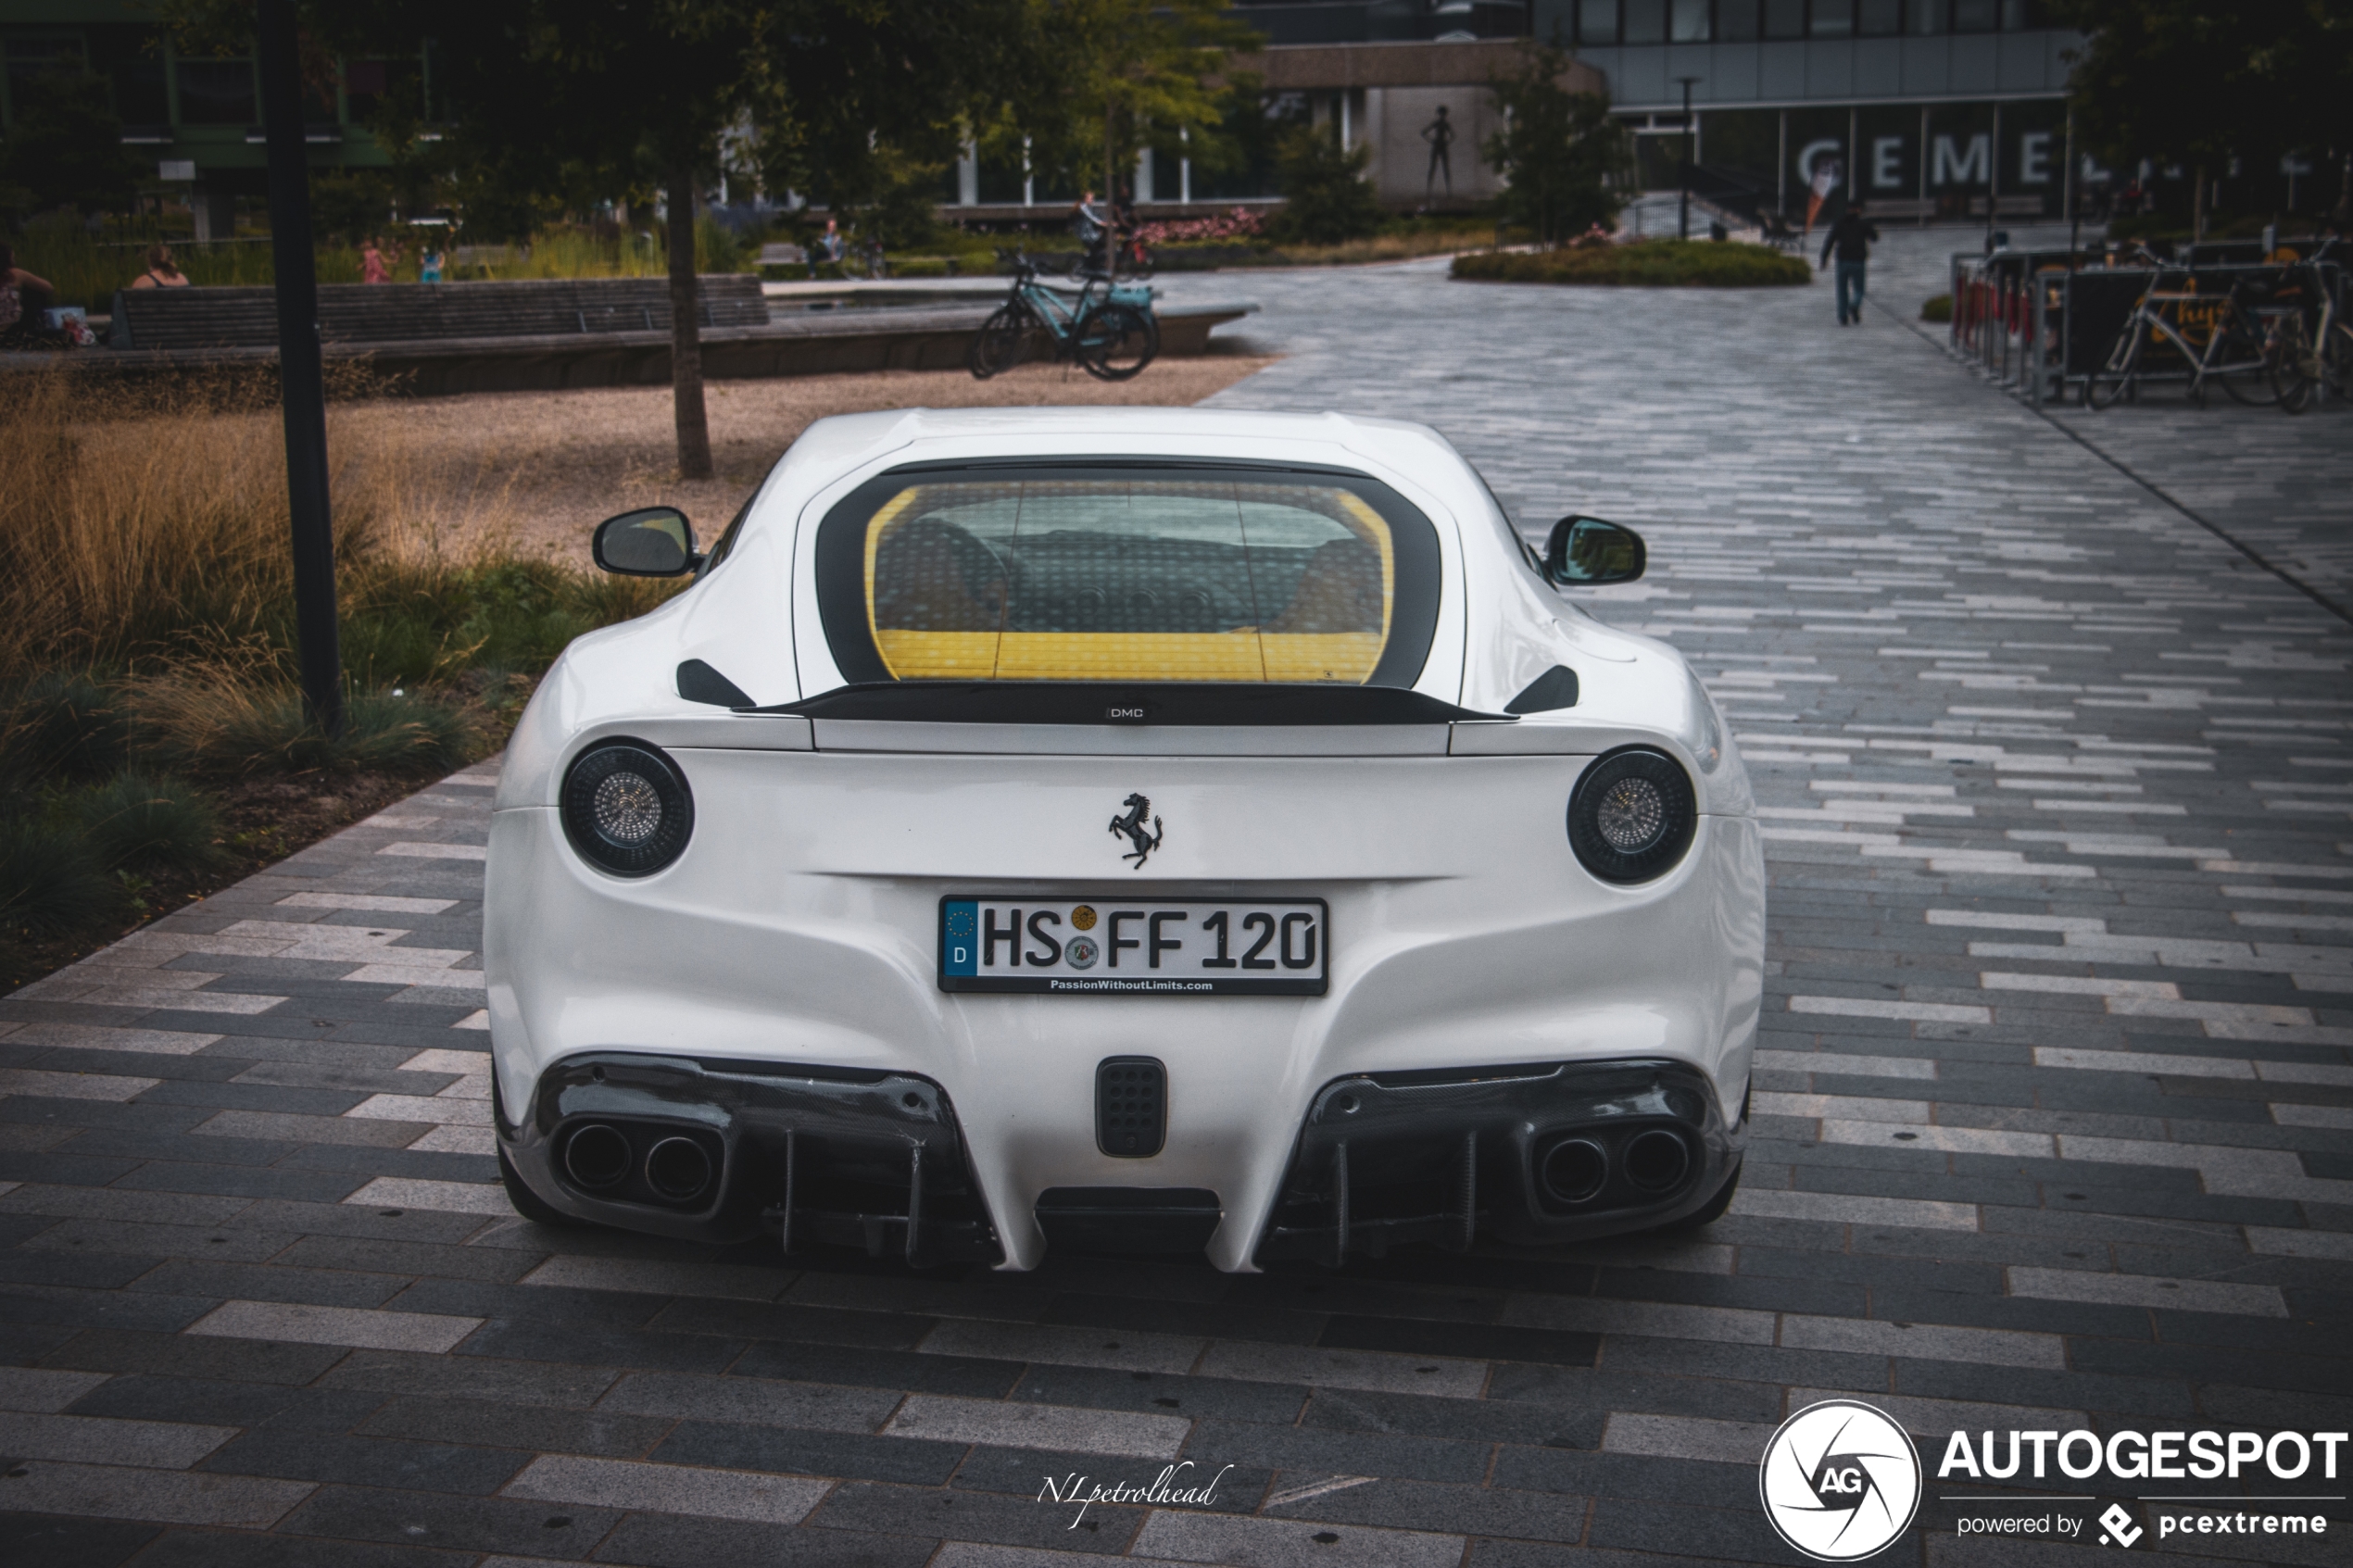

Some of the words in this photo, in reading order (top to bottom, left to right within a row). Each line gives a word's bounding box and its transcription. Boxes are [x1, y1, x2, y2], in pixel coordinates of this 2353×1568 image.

[1111, 709, 1144, 718] DMC
[983, 908, 1063, 968] HS
[1107, 910, 1189, 969] FF
[1202, 910, 1316, 970] 120
[954, 947, 966, 963] D
[1051, 980, 1214, 990] PassionWithoutLimits.com
